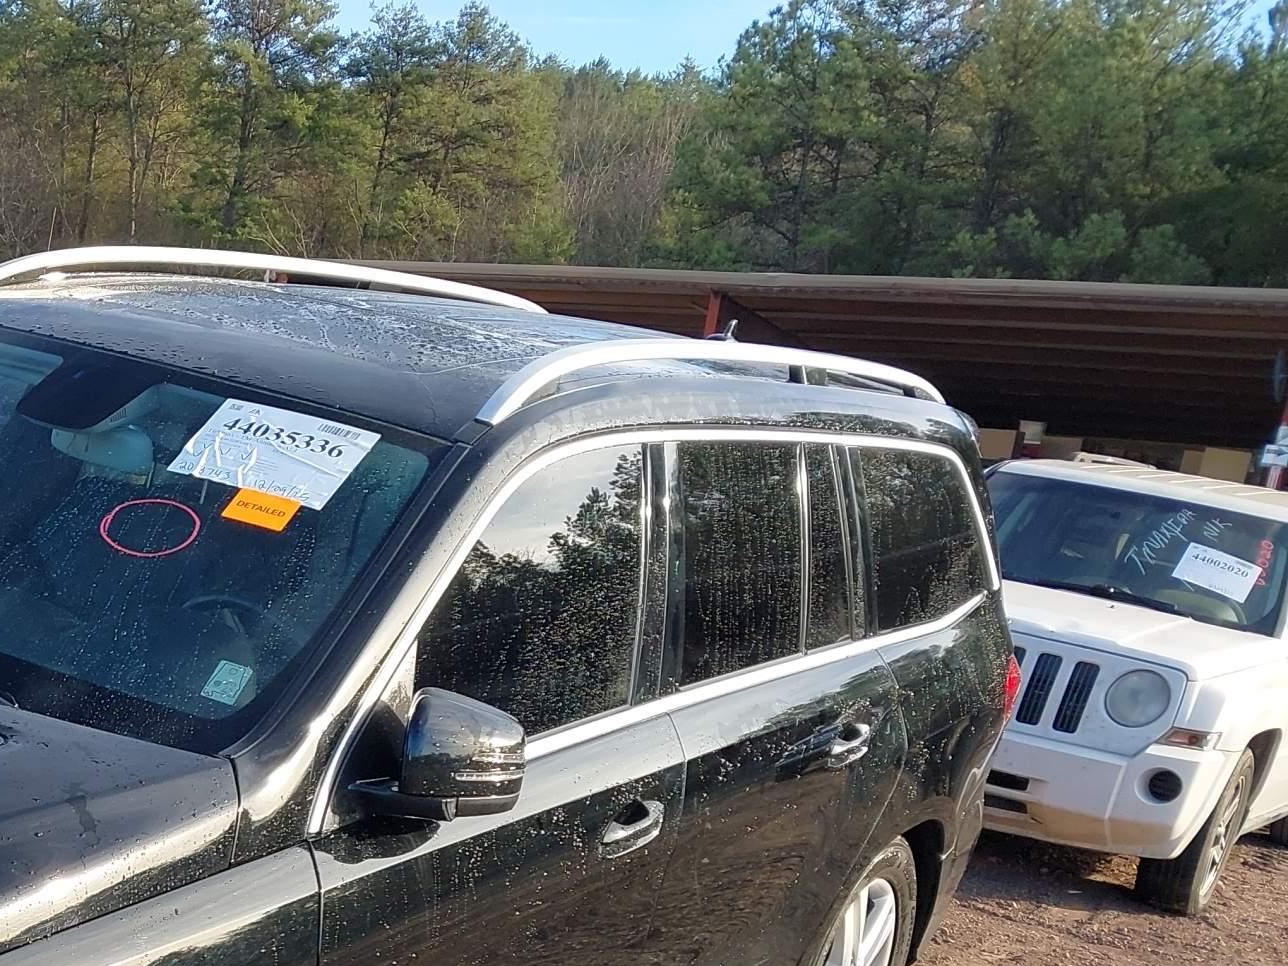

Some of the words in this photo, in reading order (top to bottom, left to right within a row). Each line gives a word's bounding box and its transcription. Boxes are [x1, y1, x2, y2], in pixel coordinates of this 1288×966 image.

[223, 418, 350, 459] 44035336
[235, 499, 286, 518] DETAILED
[1190, 552, 1250, 579] 44002020
